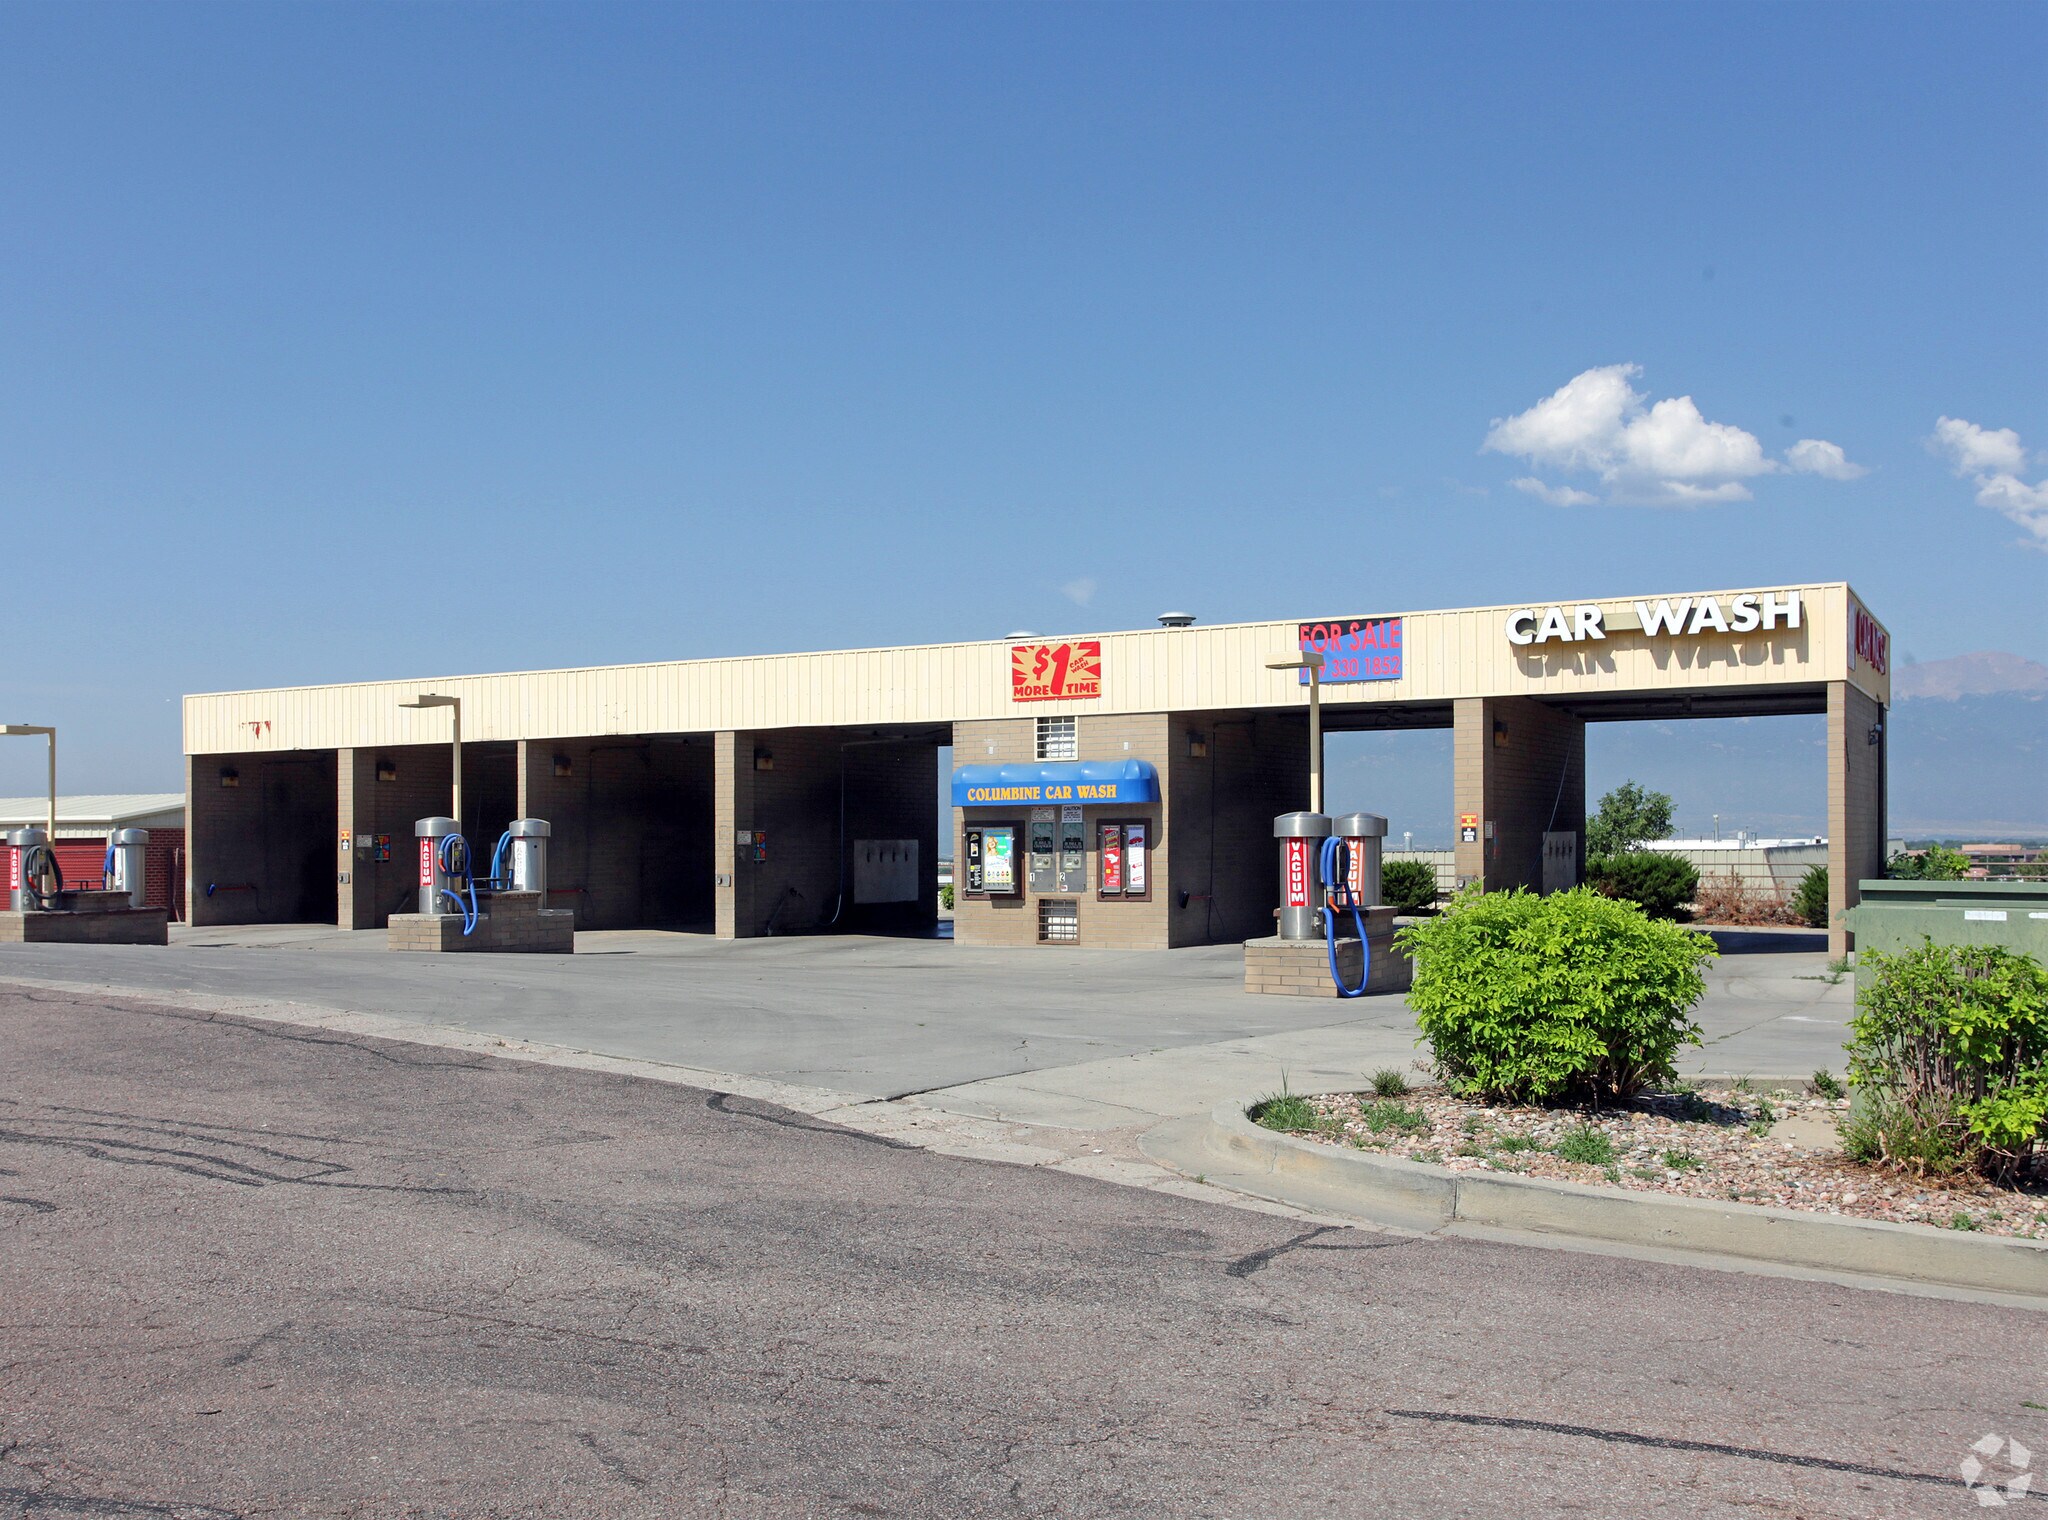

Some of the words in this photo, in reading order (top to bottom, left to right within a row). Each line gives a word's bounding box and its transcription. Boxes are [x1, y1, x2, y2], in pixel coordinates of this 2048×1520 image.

[1505, 604, 1607, 646] CAR
[1634, 590, 1801, 637] WASH
[1300, 624, 1342, 653] FOR
[1349, 619, 1401, 652] SALE
[1032, 643, 1071, 695] $1
[1069, 656, 1084, 669] CAR
[1070, 660, 1089, 674] WASH
[1331, 658, 1359, 678] 330
[1365, 656, 1401, 676] 1852
[1013, 685, 1050, 697] MORE
[1066, 682, 1099, 694] TIME
[967, 786, 1041, 801] COLUMBINE
[1045, 785, 1072, 799] CAR
[1077, 784, 1117, 799] WASH
[423, 837, 431, 884] VACUUM
[1291, 842, 1304, 902] VACUUM
